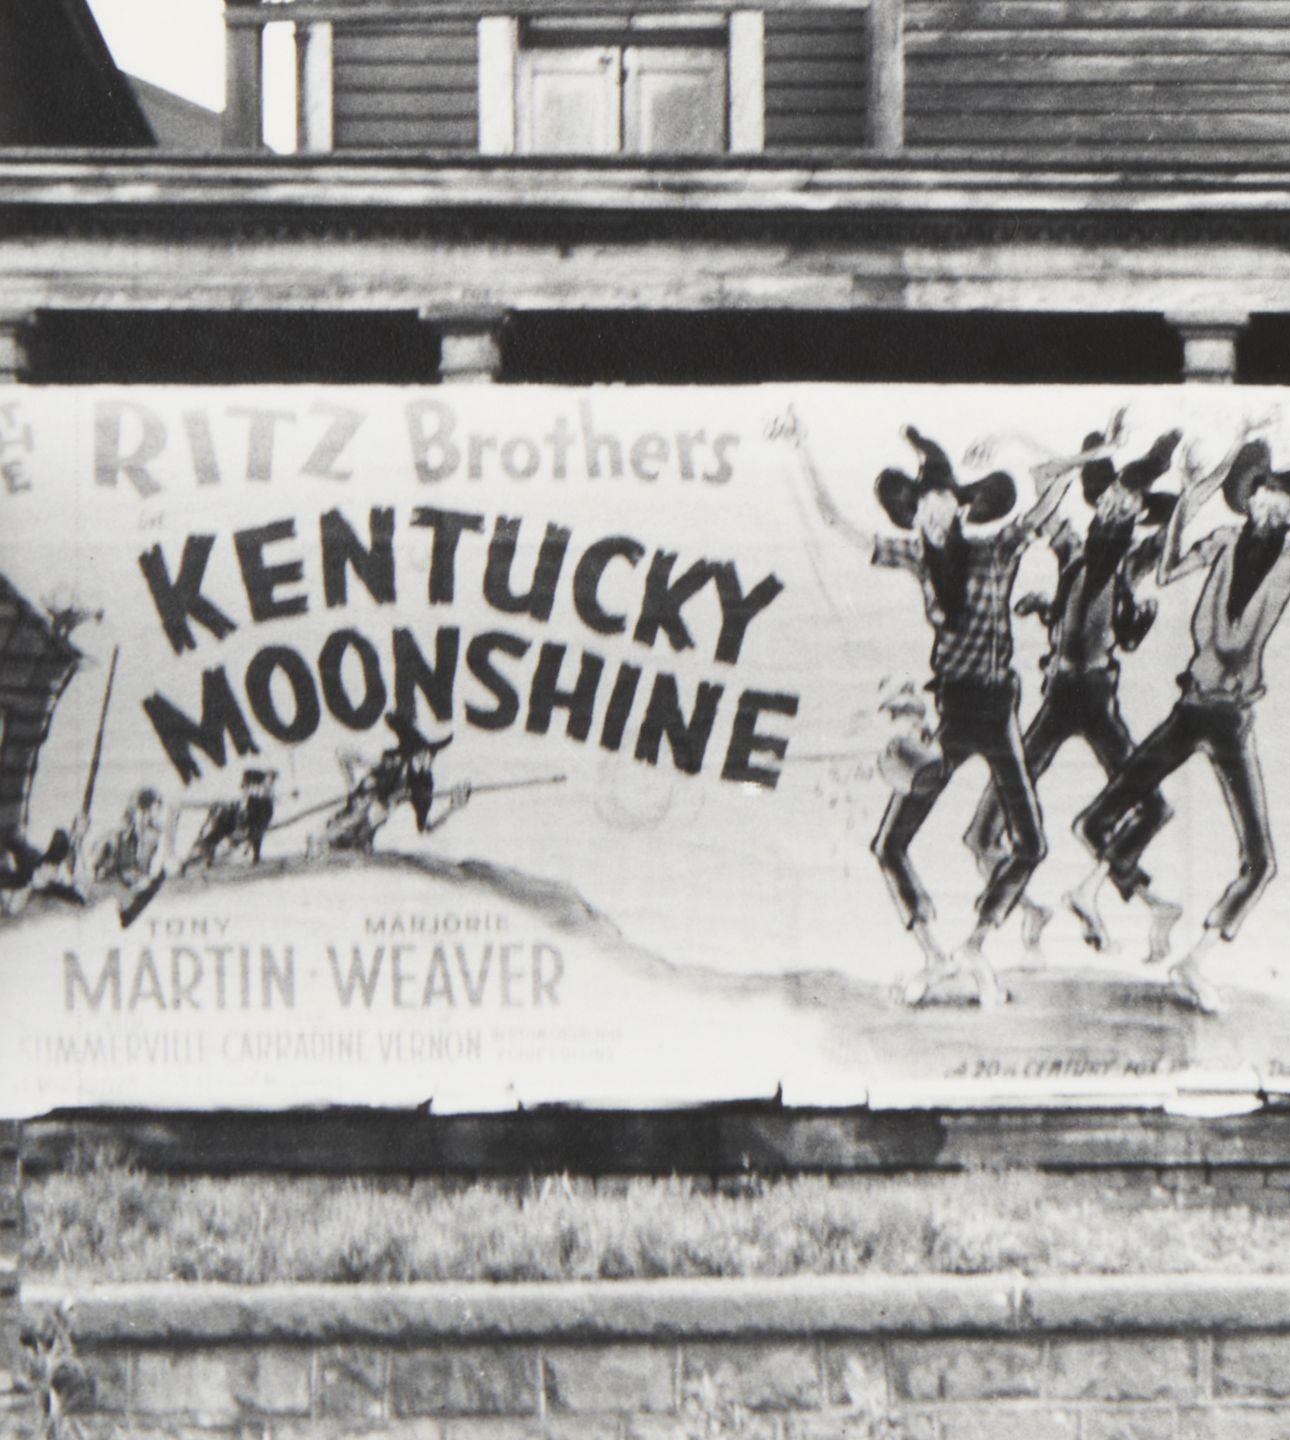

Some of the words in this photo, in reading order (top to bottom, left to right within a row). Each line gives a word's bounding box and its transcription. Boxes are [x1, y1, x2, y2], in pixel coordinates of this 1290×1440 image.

[94, 400, 369, 498] RITZ
[404, 398, 741, 485] Brothers
[138, 505, 784, 665] KENTUCKY
[143, 626, 800, 791] MOONSHINE
[147, 917, 231, 937] TONY
[364, 913, 510, 936] MARJORIE
[63, 944, 295, 1011] MARTIN
[326, 942, 565, 1010] WEAVER
[222, 1028, 368, 1062] CARRADINE
[379, 1027, 484, 1062] VERNON
